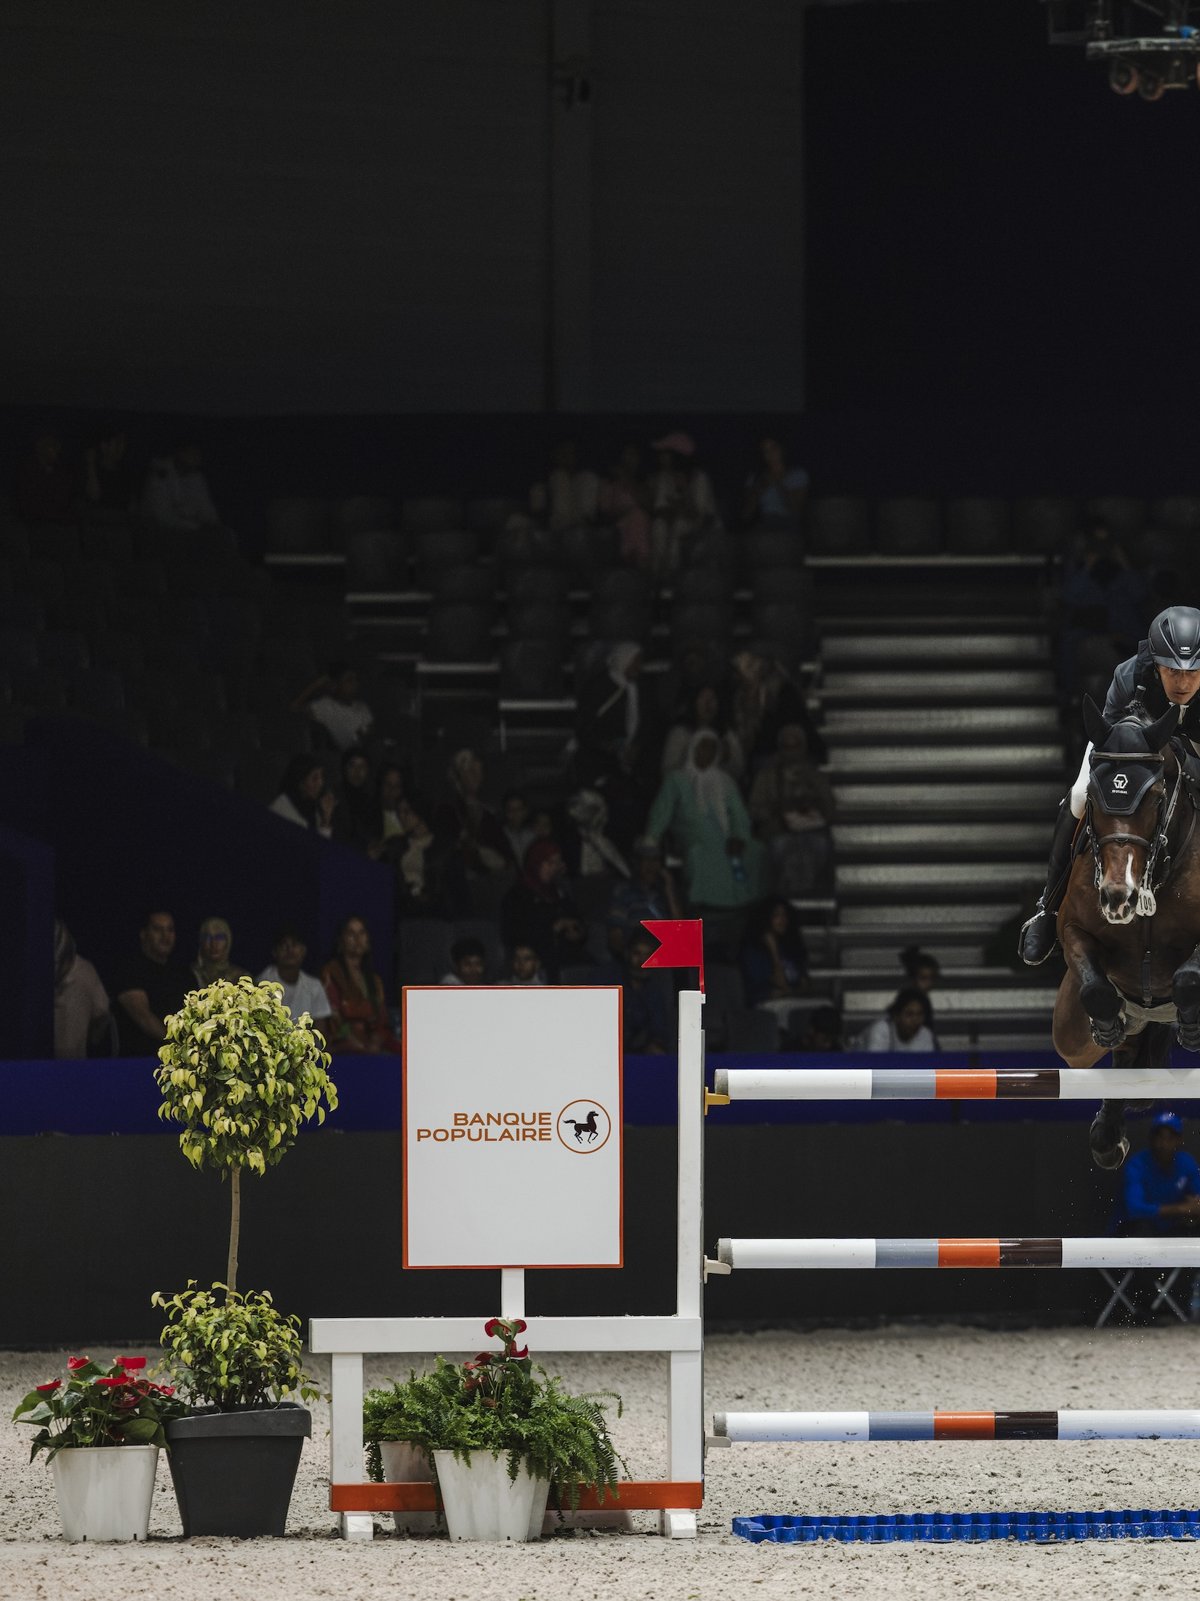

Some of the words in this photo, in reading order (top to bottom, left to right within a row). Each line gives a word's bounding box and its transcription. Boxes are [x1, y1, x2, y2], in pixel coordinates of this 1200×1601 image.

[1138, 894, 1153, 912] 109
[453, 1112, 552, 1126] BANQUE
[417, 1127, 552, 1142] POPULAIRE
